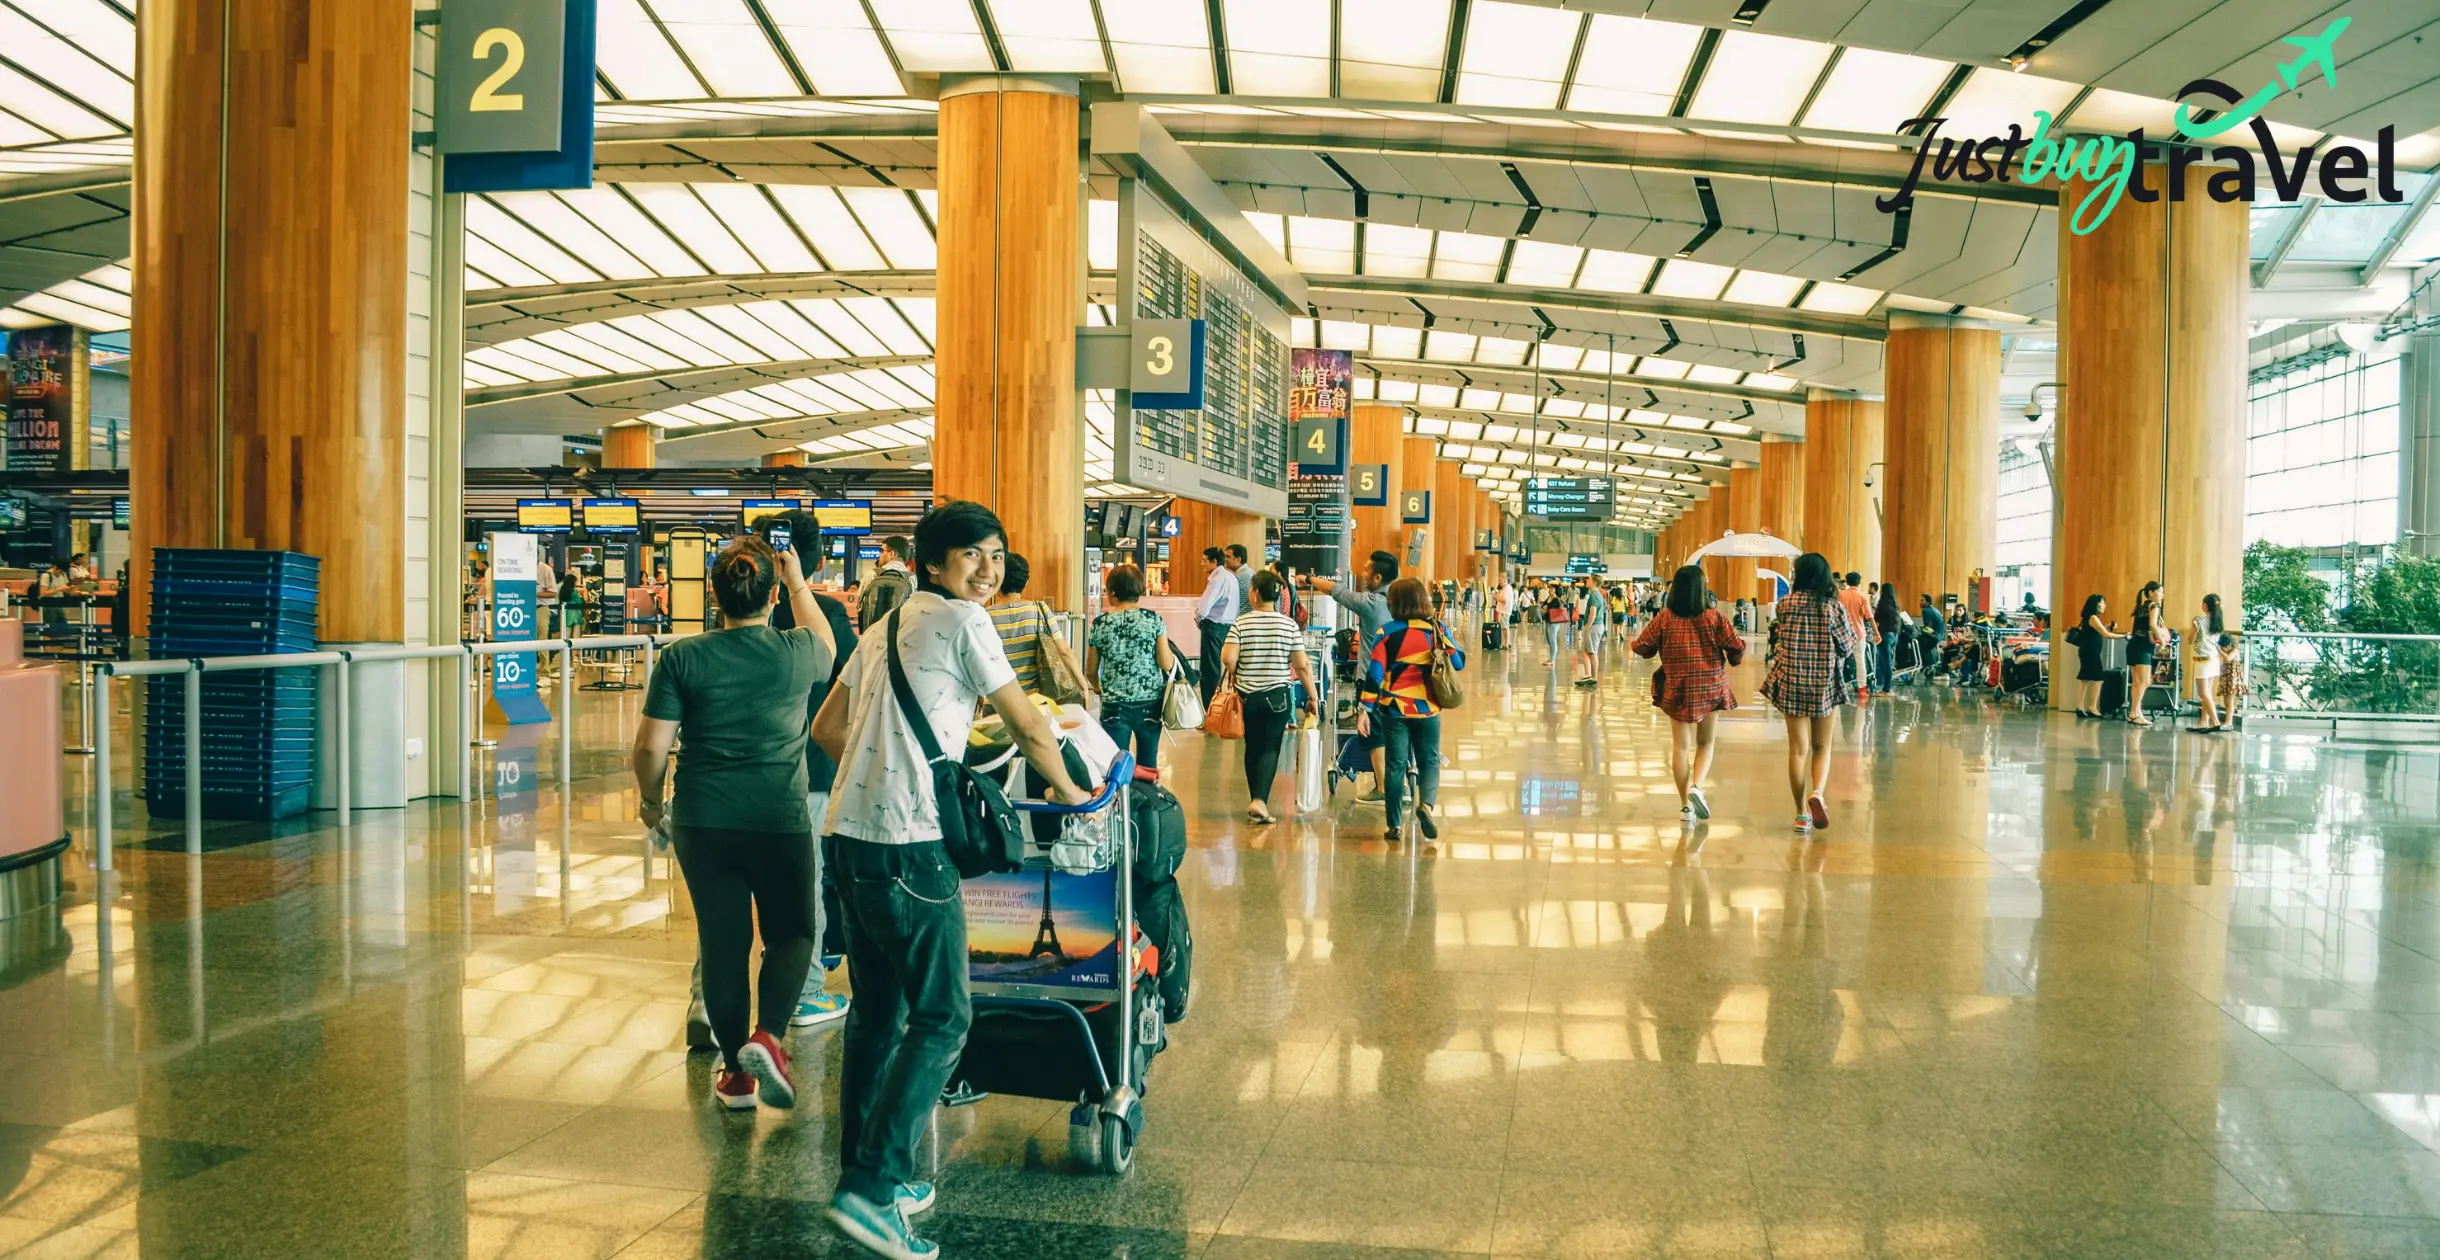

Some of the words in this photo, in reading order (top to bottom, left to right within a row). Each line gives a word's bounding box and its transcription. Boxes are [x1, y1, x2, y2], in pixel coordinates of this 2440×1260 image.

[470, 27, 525, 112] 2
[1147, 336, 1174, 375] 3
[1307, 428, 1325, 454] 4
[1360, 472, 1374, 491] 5
[1408, 497, 1420, 512] 6
[1164, 518, 1178, 535] 4
[1478, 533, 1486, 543] 7
[1491, 539, 1498, 548] 8
[1511, 544, 1517, 552] 9
[497, 607, 524, 628] 60
[497, 661, 520, 682] 10
[964, 888, 981, 897] WIN
[982, 889, 1000, 898] FREE
[962, 898, 983, 907] ANGI
[984, 899, 1024, 908] REWARDS
[1071, 974, 1110, 983] REWARDS
